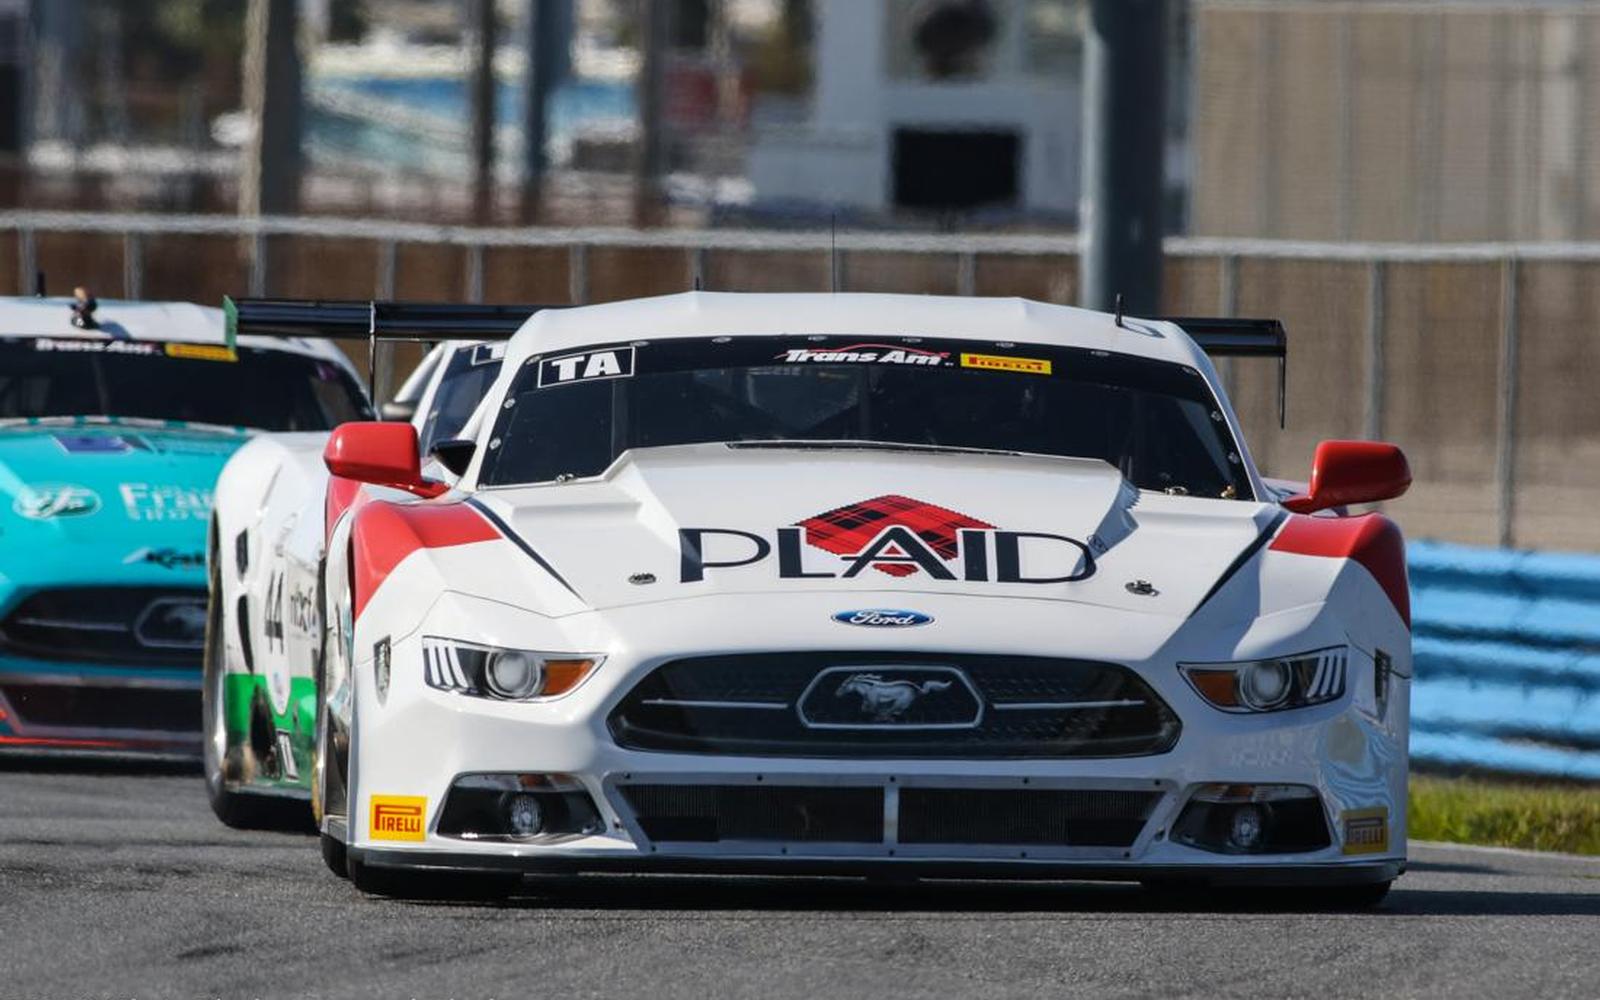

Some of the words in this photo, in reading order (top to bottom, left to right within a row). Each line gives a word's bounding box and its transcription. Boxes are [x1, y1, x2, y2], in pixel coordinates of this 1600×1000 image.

[551, 351, 621, 381] TA
[782, 349, 877, 362] Trans
[880, 350, 941, 366] Am
[679, 525, 1097, 584] PLAID
[264, 569, 284, 655] 44
[848, 609, 916, 625] Ford
[374, 803, 422, 834] PIRELLI
